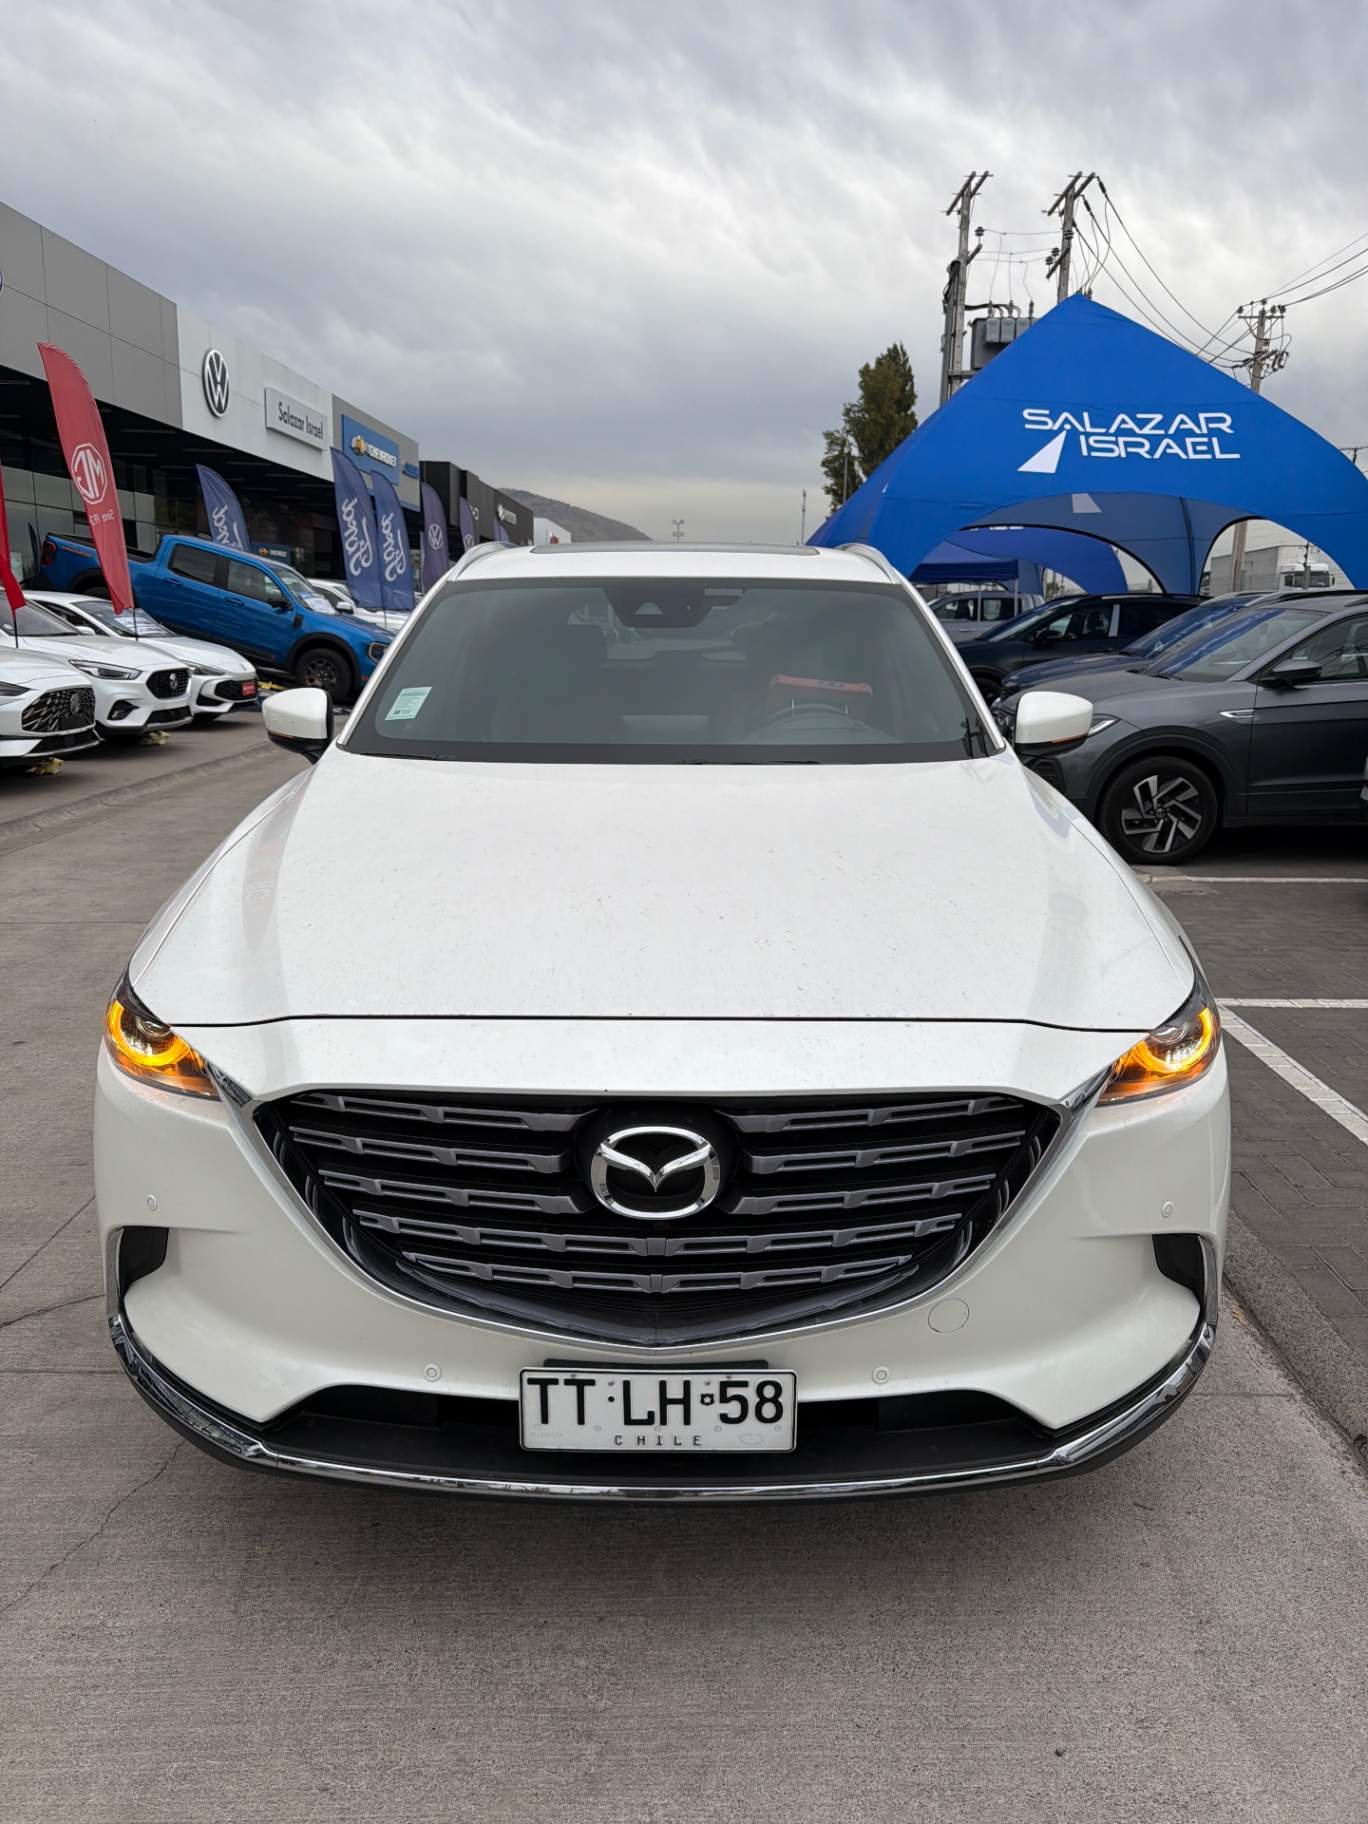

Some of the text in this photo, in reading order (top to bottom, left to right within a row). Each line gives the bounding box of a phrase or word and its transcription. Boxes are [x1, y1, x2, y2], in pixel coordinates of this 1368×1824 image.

[278, 401, 323, 440] Salazar Israel
[1022, 408, 1235, 434] SALAZAR
[1080, 434, 1241, 459] ISRAEL
[613, 1434, 702, 1447] CHILE
